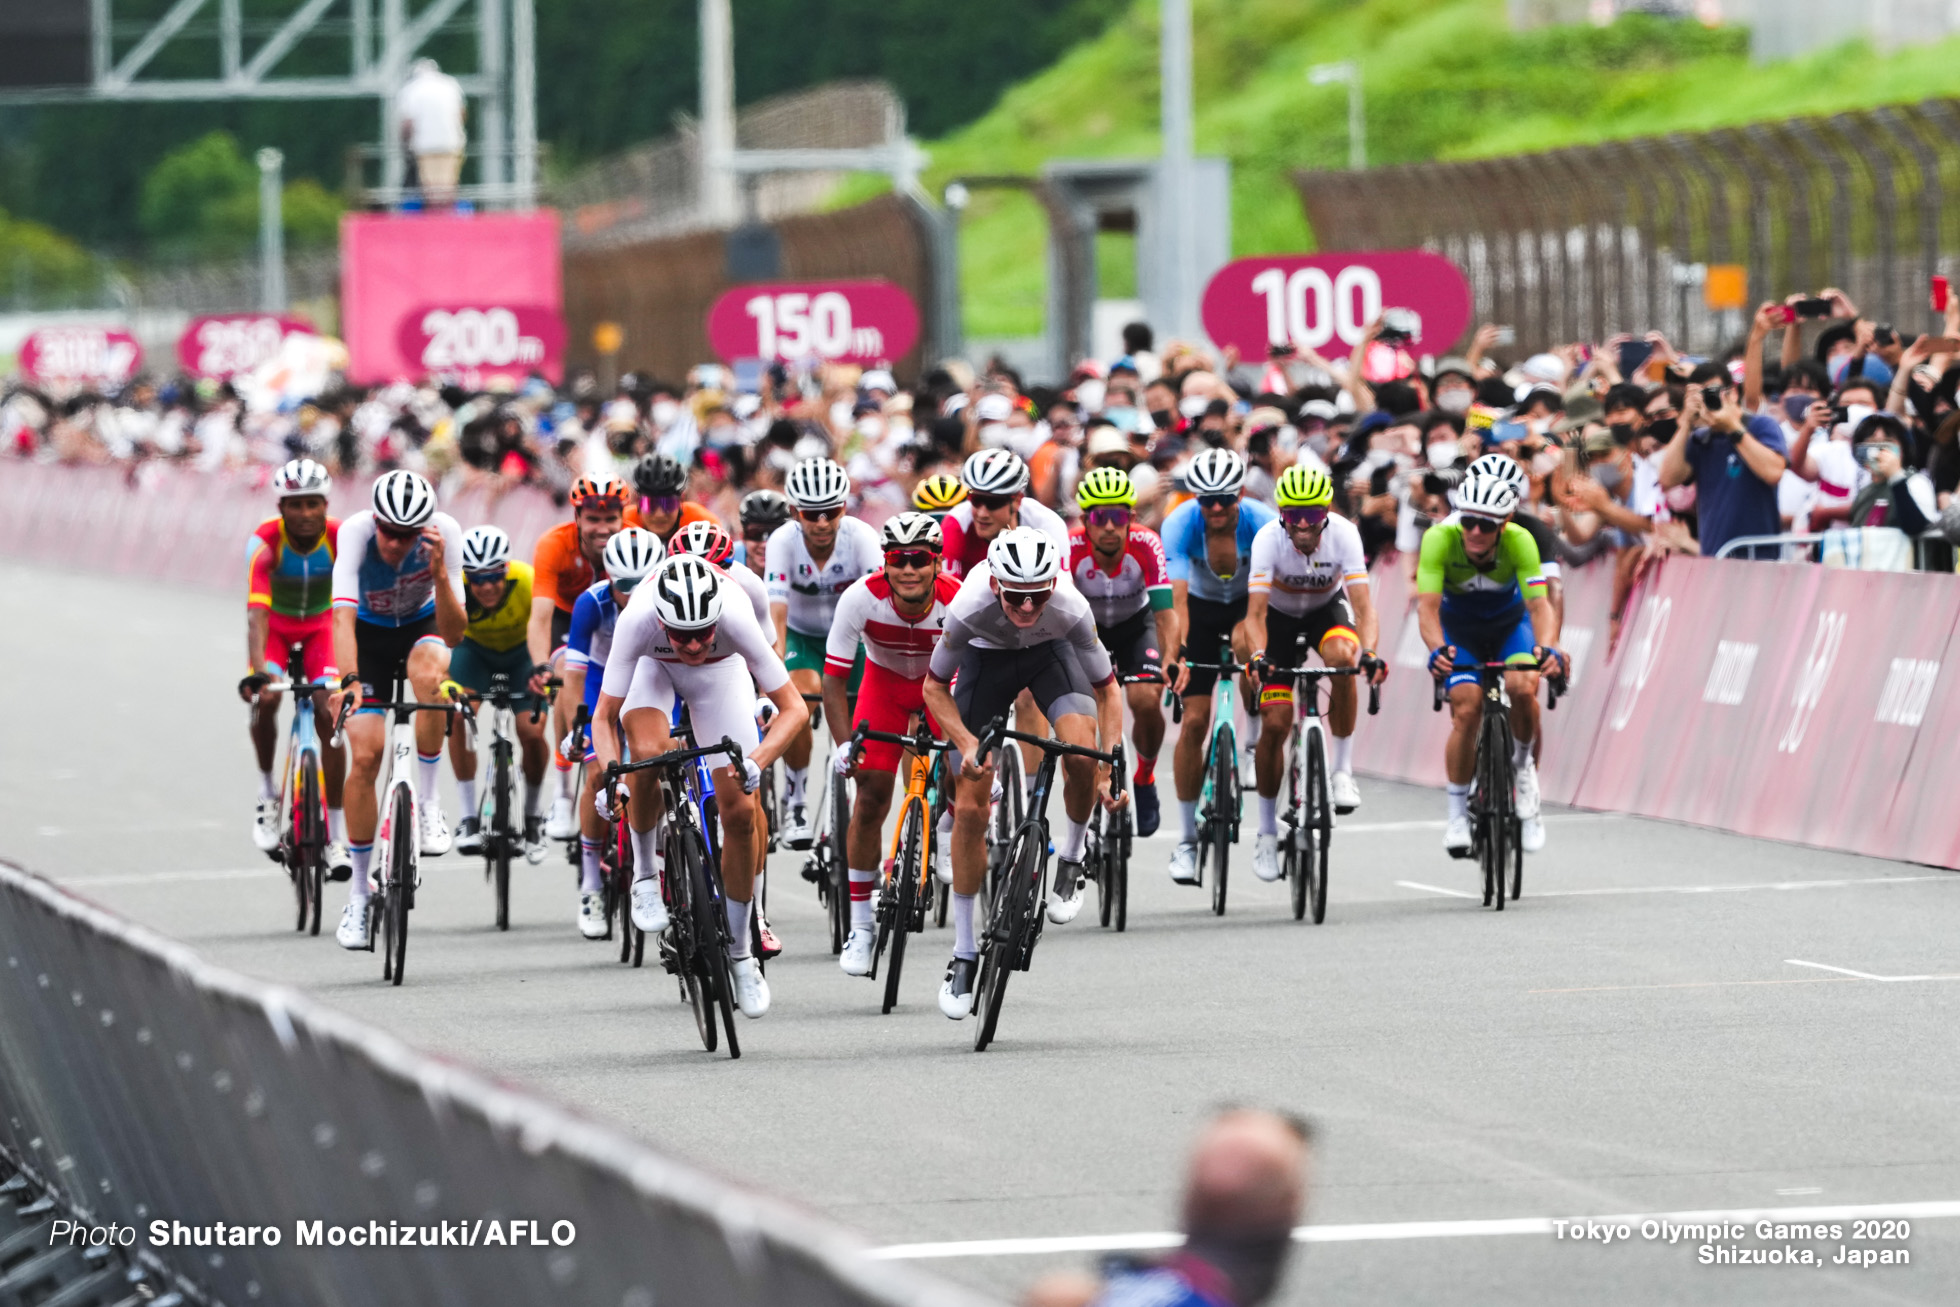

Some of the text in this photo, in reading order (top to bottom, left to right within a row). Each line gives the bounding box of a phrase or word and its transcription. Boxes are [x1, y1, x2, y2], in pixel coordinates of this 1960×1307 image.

[421, 307, 545, 367] 200m
[745, 291, 885, 361] 150m
[1252, 265, 1382, 348] 100
[1129, 531, 1167, 583] PORTUGAL
